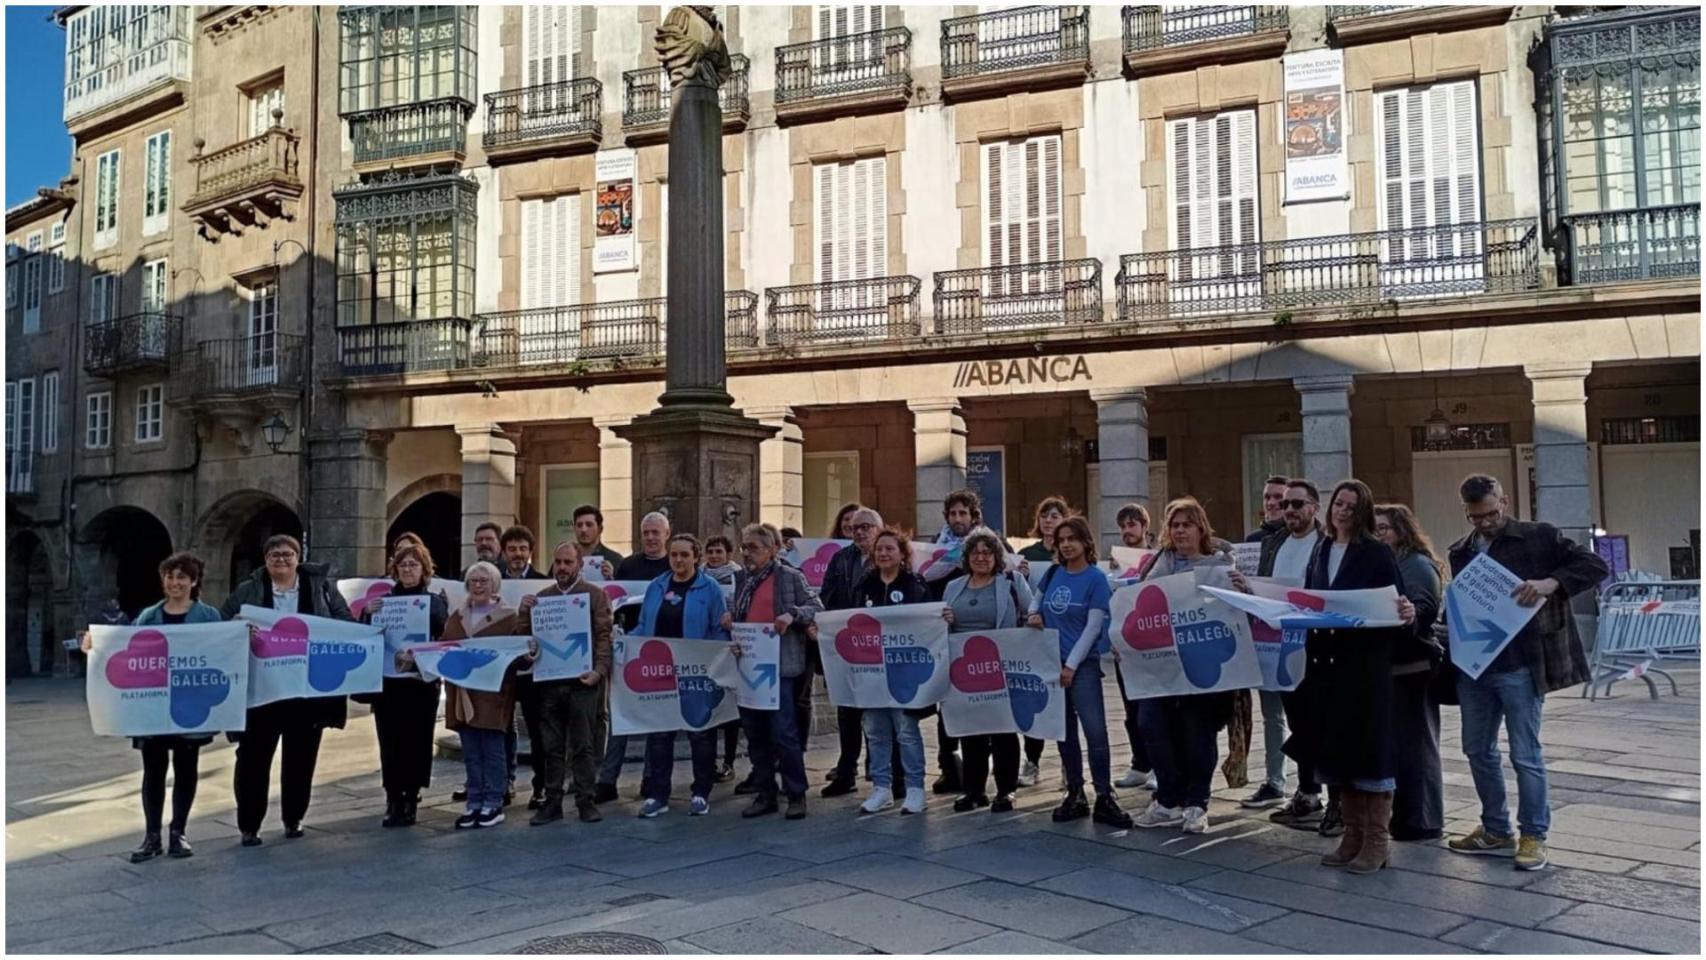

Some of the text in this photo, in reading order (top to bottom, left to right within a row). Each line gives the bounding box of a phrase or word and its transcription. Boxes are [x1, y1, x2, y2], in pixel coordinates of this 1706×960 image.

[1469, 565, 1481, 574] de
[1479, 556, 1516, 588] Mudemos
[1462, 571, 1498, 601] O galego
[1137, 608, 1207, 631] QUEREMOS
[851, 634, 916, 648] QUEREMOS
[1177, 625, 1232, 645] GALEGO
[1283, 630, 1306, 645] GAL
[310, 644, 365, 655] GALEGO
[128, 655, 207, 671] QUEREMOS
[886, 652, 934, 664] GALEGO
[642, 664, 708, 677] QUEREMOS
[968, 660, 1032, 676] QUEREMOS
[172, 672, 228, 687] GALEGO
[1007, 677, 1046, 693] GALEGO
[121, 690, 168, 700] PLATAFORMA
